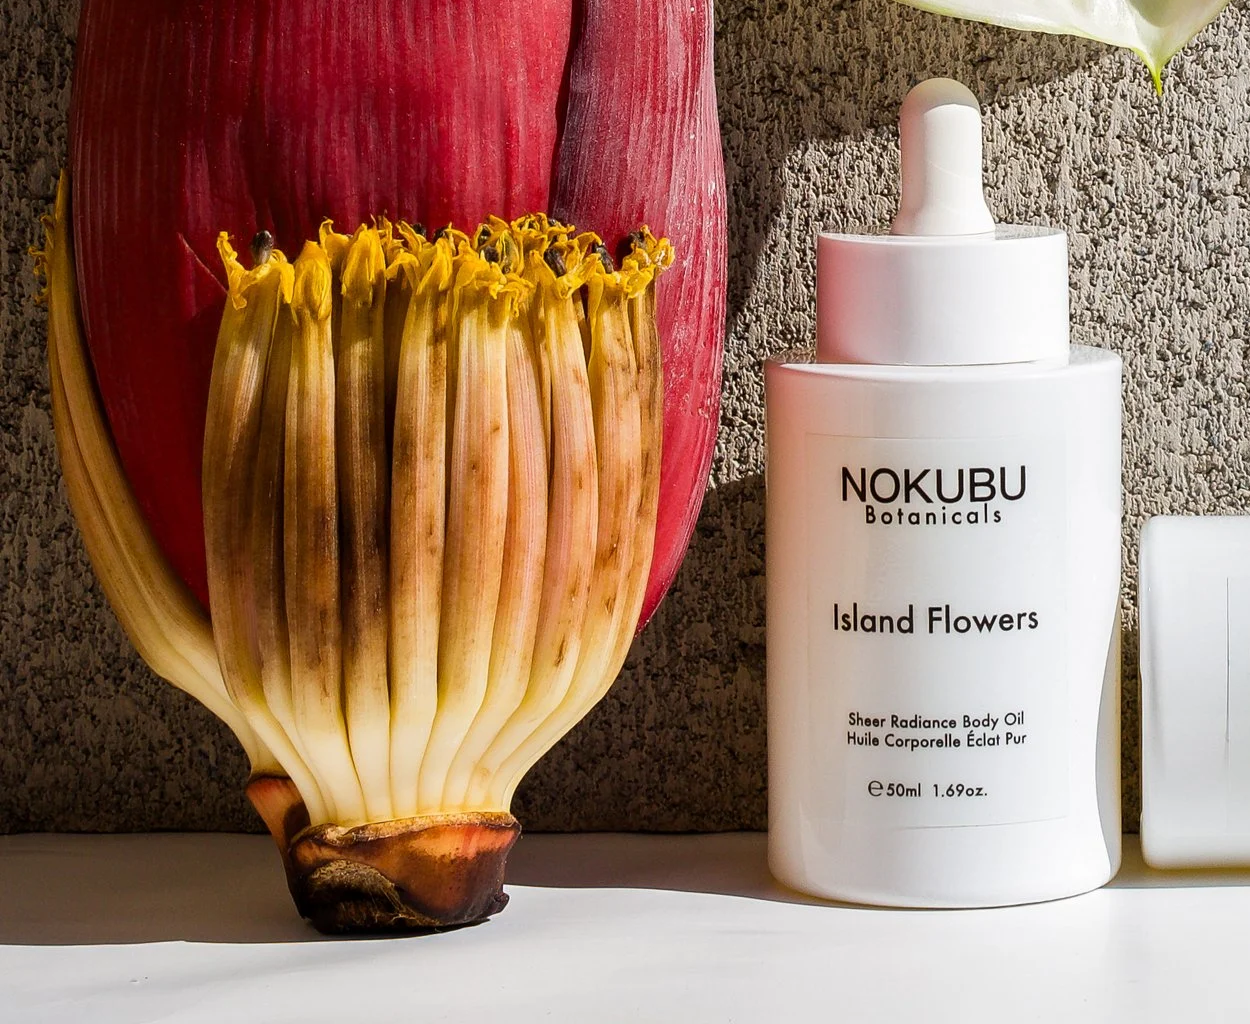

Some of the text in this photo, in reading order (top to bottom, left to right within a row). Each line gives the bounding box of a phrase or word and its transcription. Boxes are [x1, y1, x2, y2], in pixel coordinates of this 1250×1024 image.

[841, 464, 1027, 504] NOKUBU
[865, 502, 1002, 526] Botanicals
[833, 601, 1039, 635] Island Flowers
[848, 709, 1025, 732] Sheer Radiance Body Oil
[847, 729, 1028, 752] Huile Corporelle Éclat Pur
[932, 783, 988, 798] 1.69oz.
